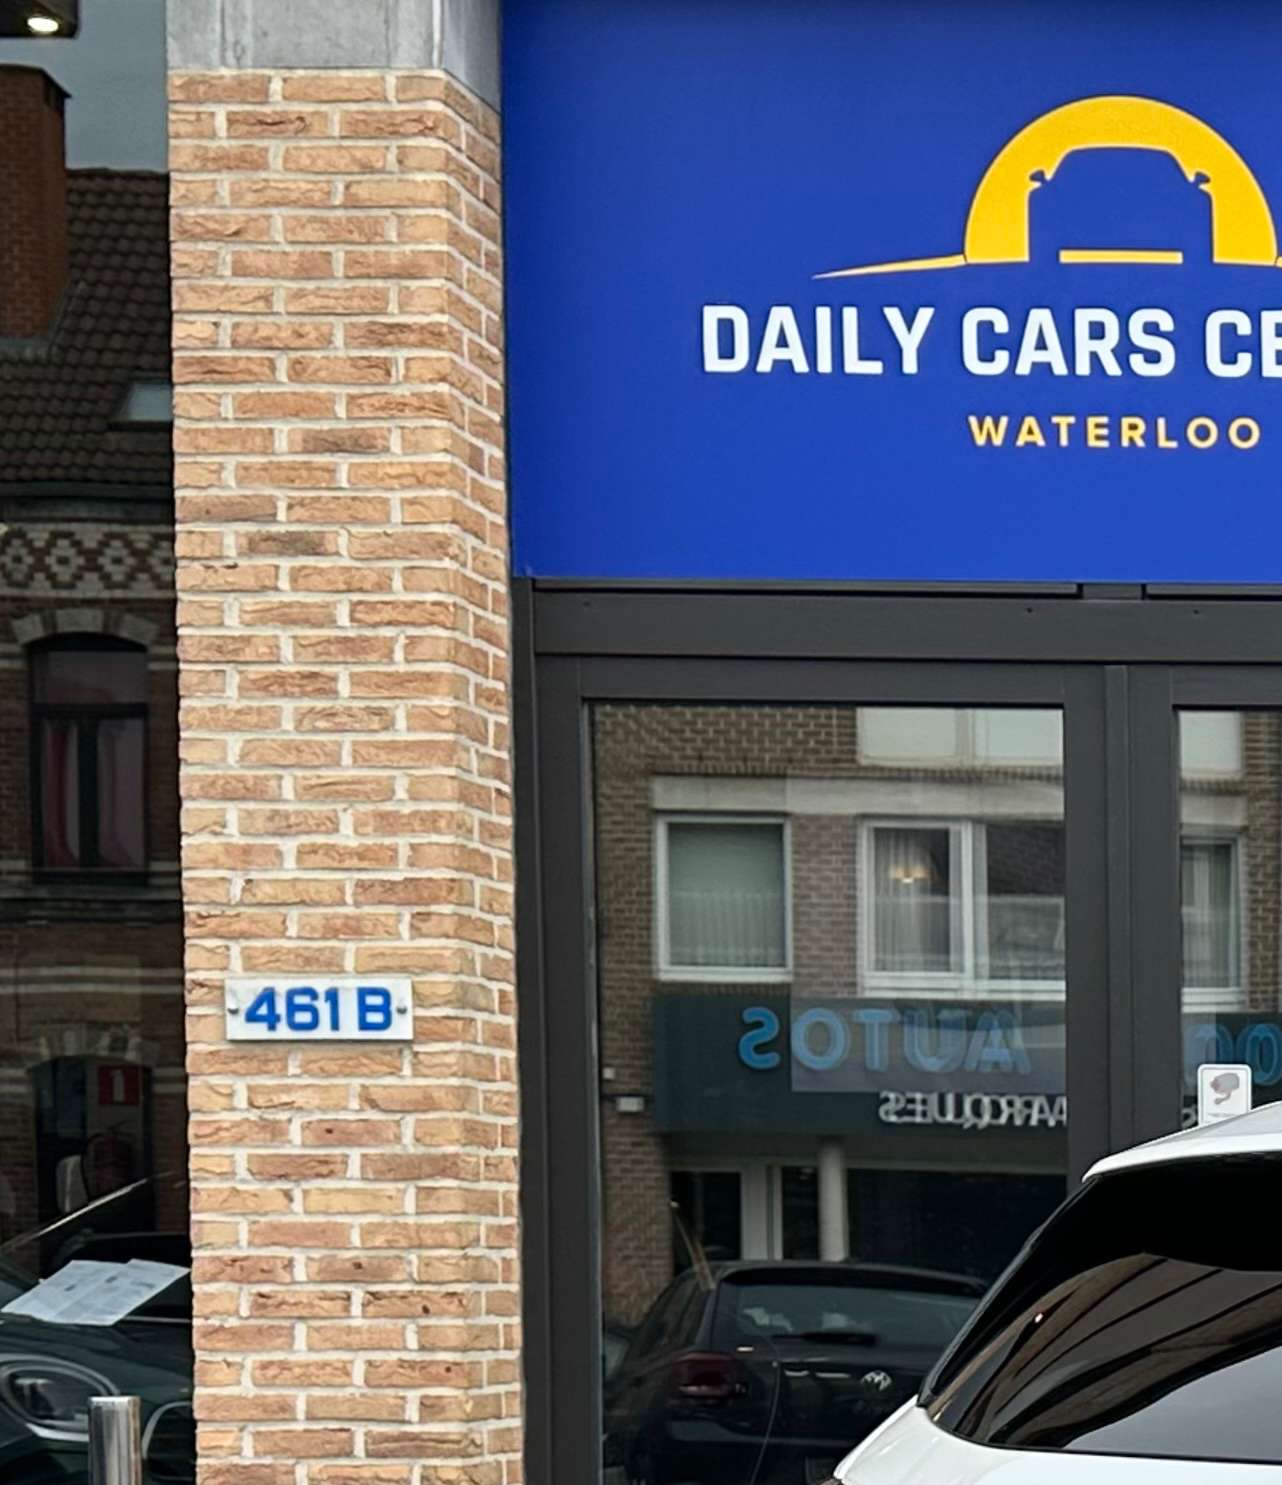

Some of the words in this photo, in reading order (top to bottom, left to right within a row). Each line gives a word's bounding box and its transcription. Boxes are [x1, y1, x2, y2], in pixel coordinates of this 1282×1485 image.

[702, 303, 936, 376] DAILY
[960, 306, 1177, 379] CARS
[967, 414, 1262, 450] WATERLOO
[243, 985, 341, 1033] 461
[356, 985, 394, 1032] B
